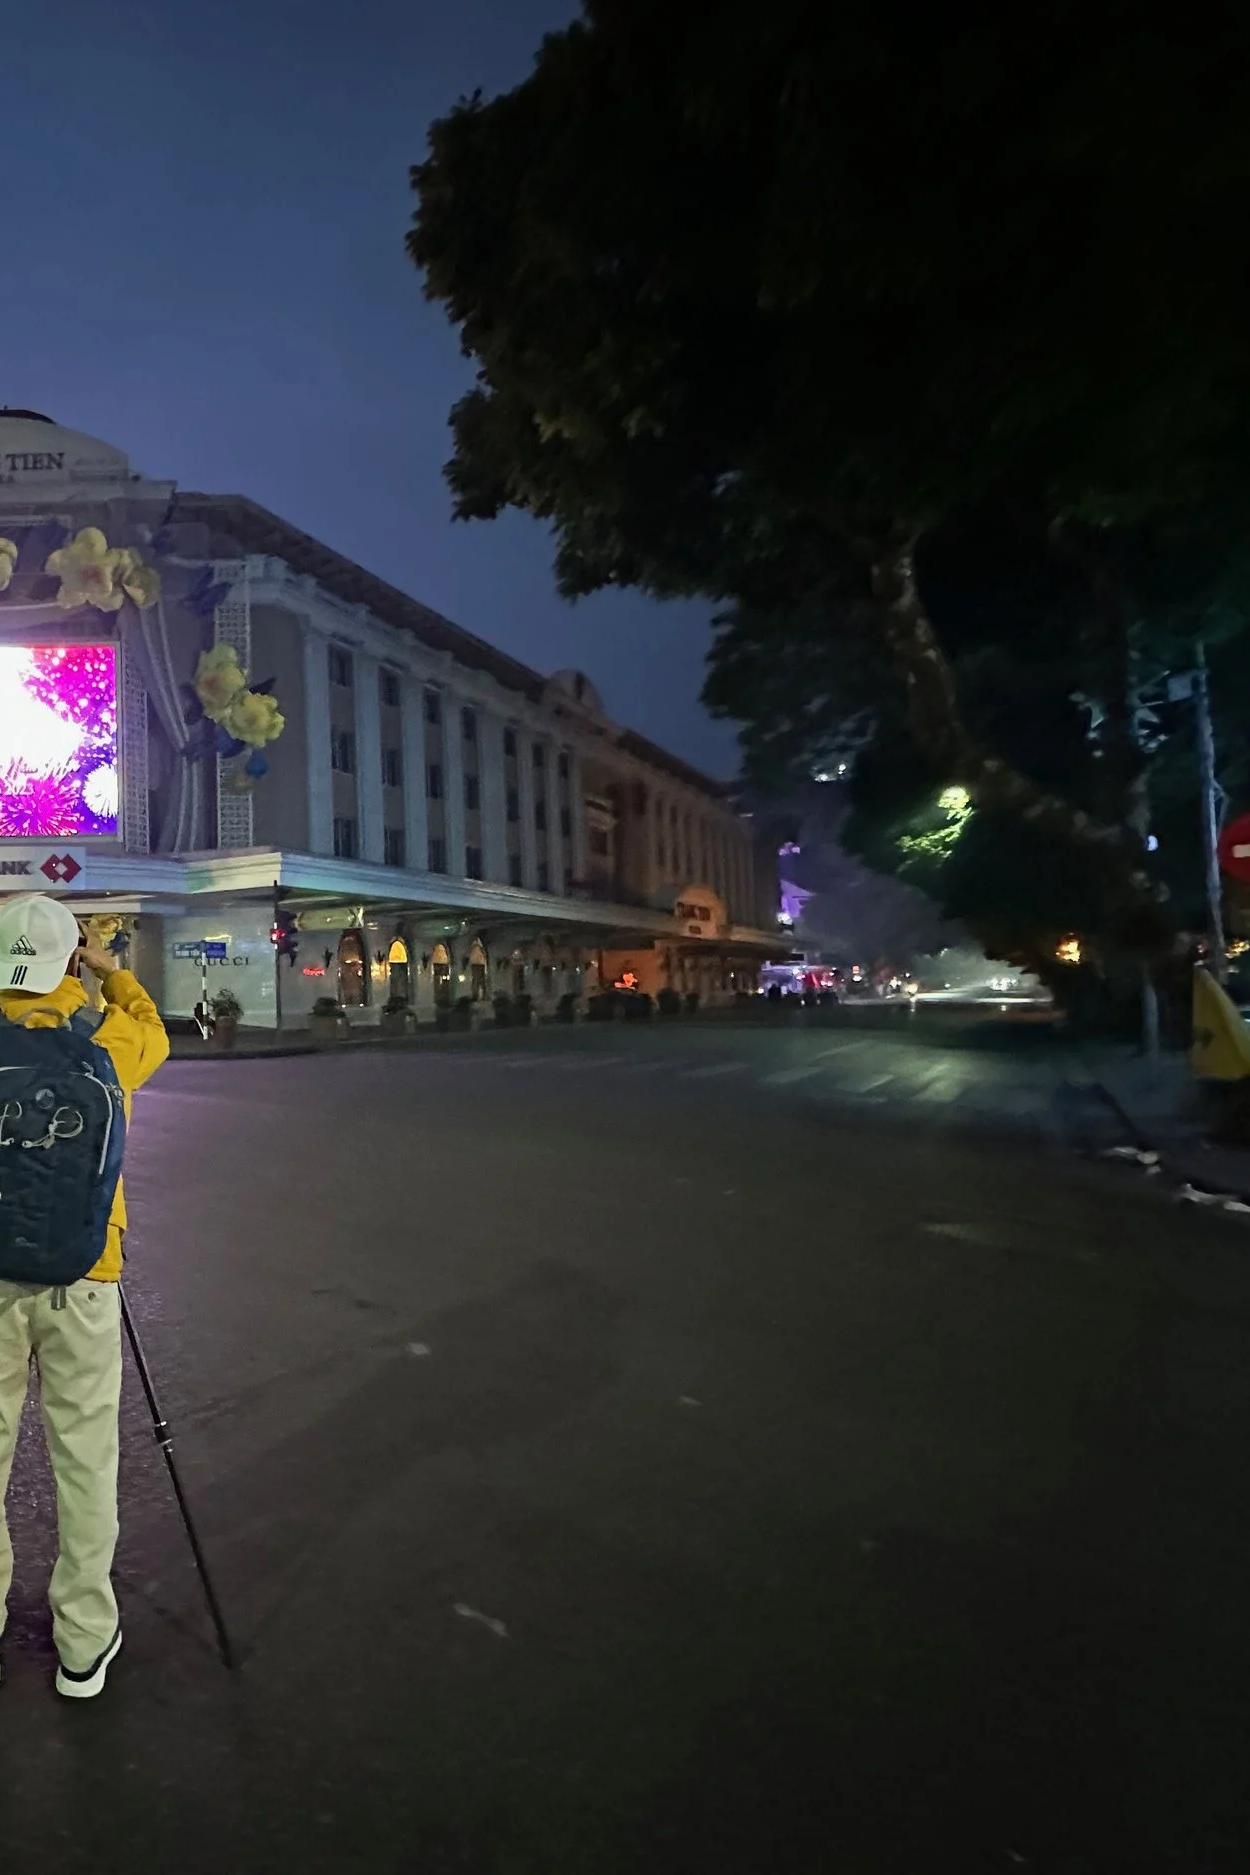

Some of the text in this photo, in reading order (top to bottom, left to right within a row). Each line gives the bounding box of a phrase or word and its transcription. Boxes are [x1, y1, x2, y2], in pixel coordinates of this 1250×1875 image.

[4, 782, 34, 796] 2023
[10, 948, 37, 956] adidas
[194, 956, 250, 967] GUCCI
